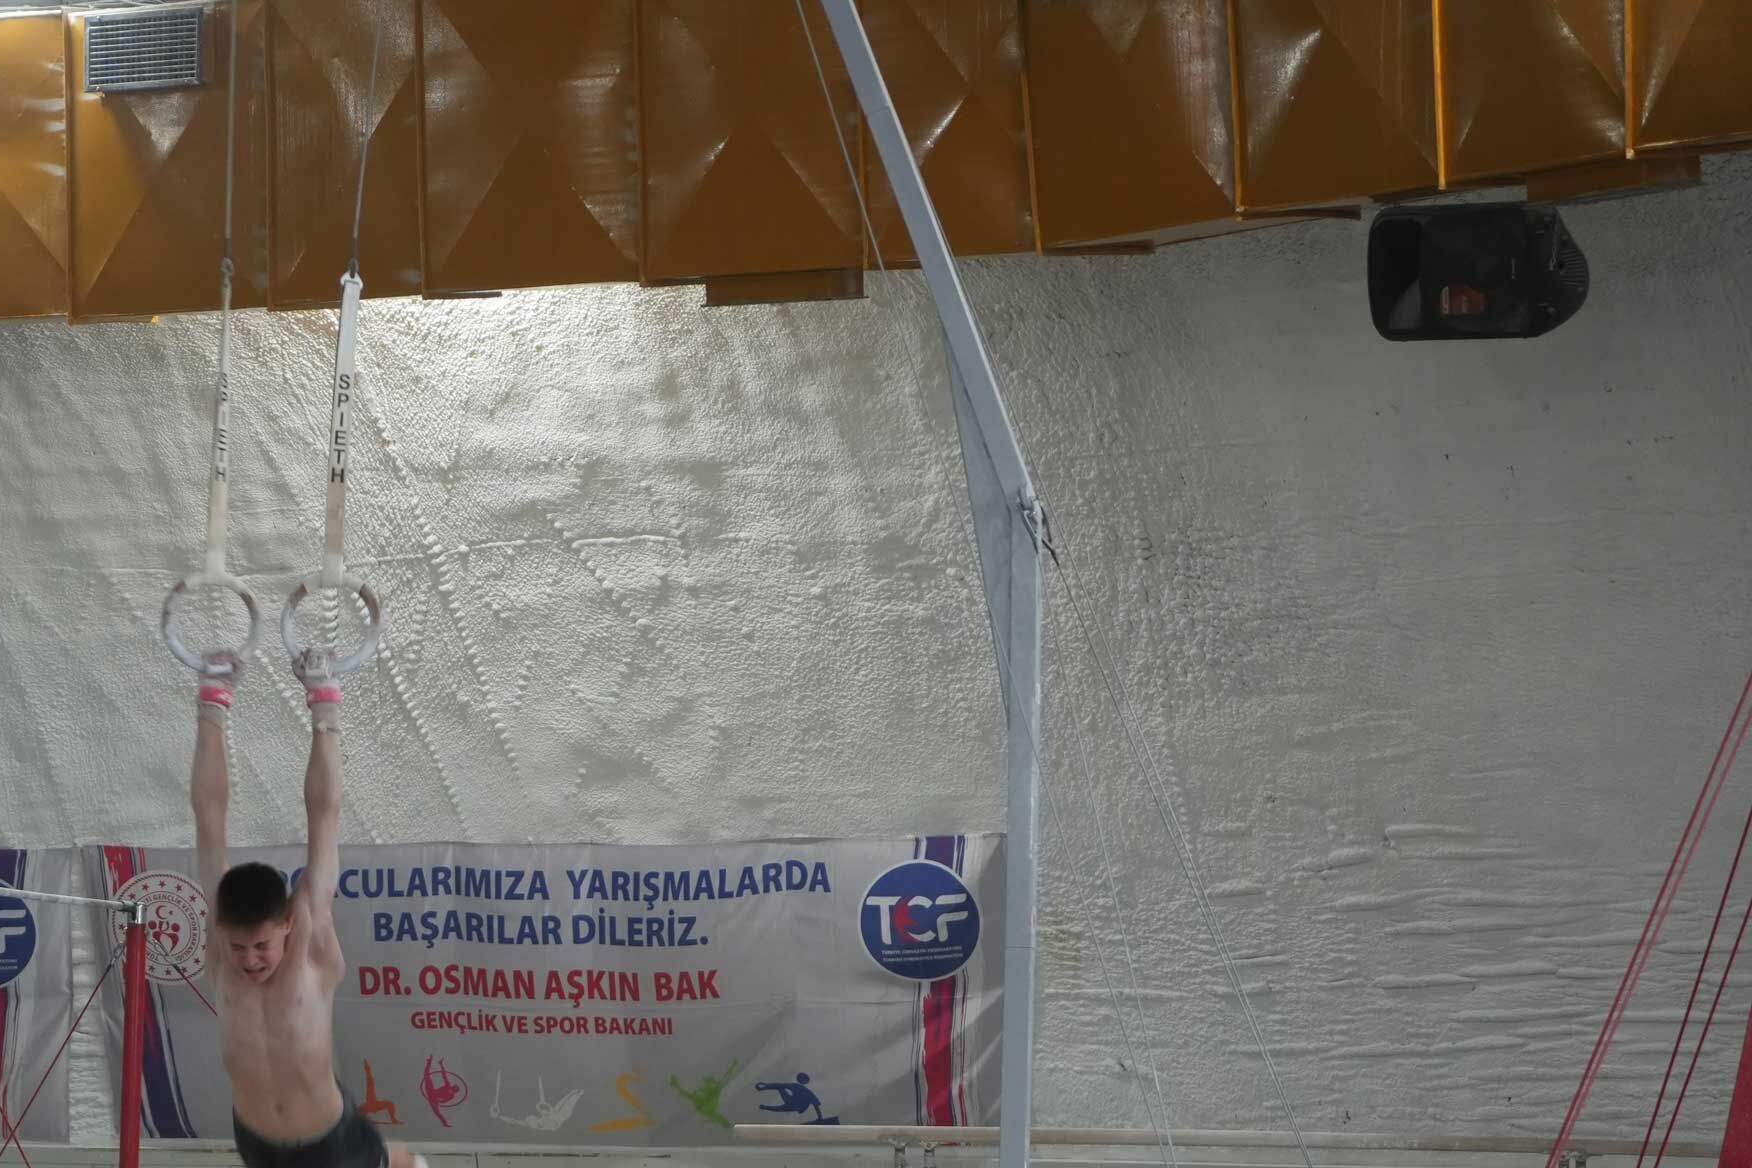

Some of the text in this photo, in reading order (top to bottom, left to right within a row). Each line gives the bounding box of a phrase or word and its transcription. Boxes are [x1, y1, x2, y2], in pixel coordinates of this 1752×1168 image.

[331, 374, 351, 484] SPIETH
[280, 860, 832, 911] CULARIMIZA YARIŞMALARDA
[373, 907, 709, 949] BAŞARILAR DİLERİZ.
[866, 892, 969, 945] TCF
[358, 964, 721, 1009] DR. OSMAN AŞKIN BAK
[410, 1009, 673, 1036] GENÇLİK VE SPOR BAKANI
